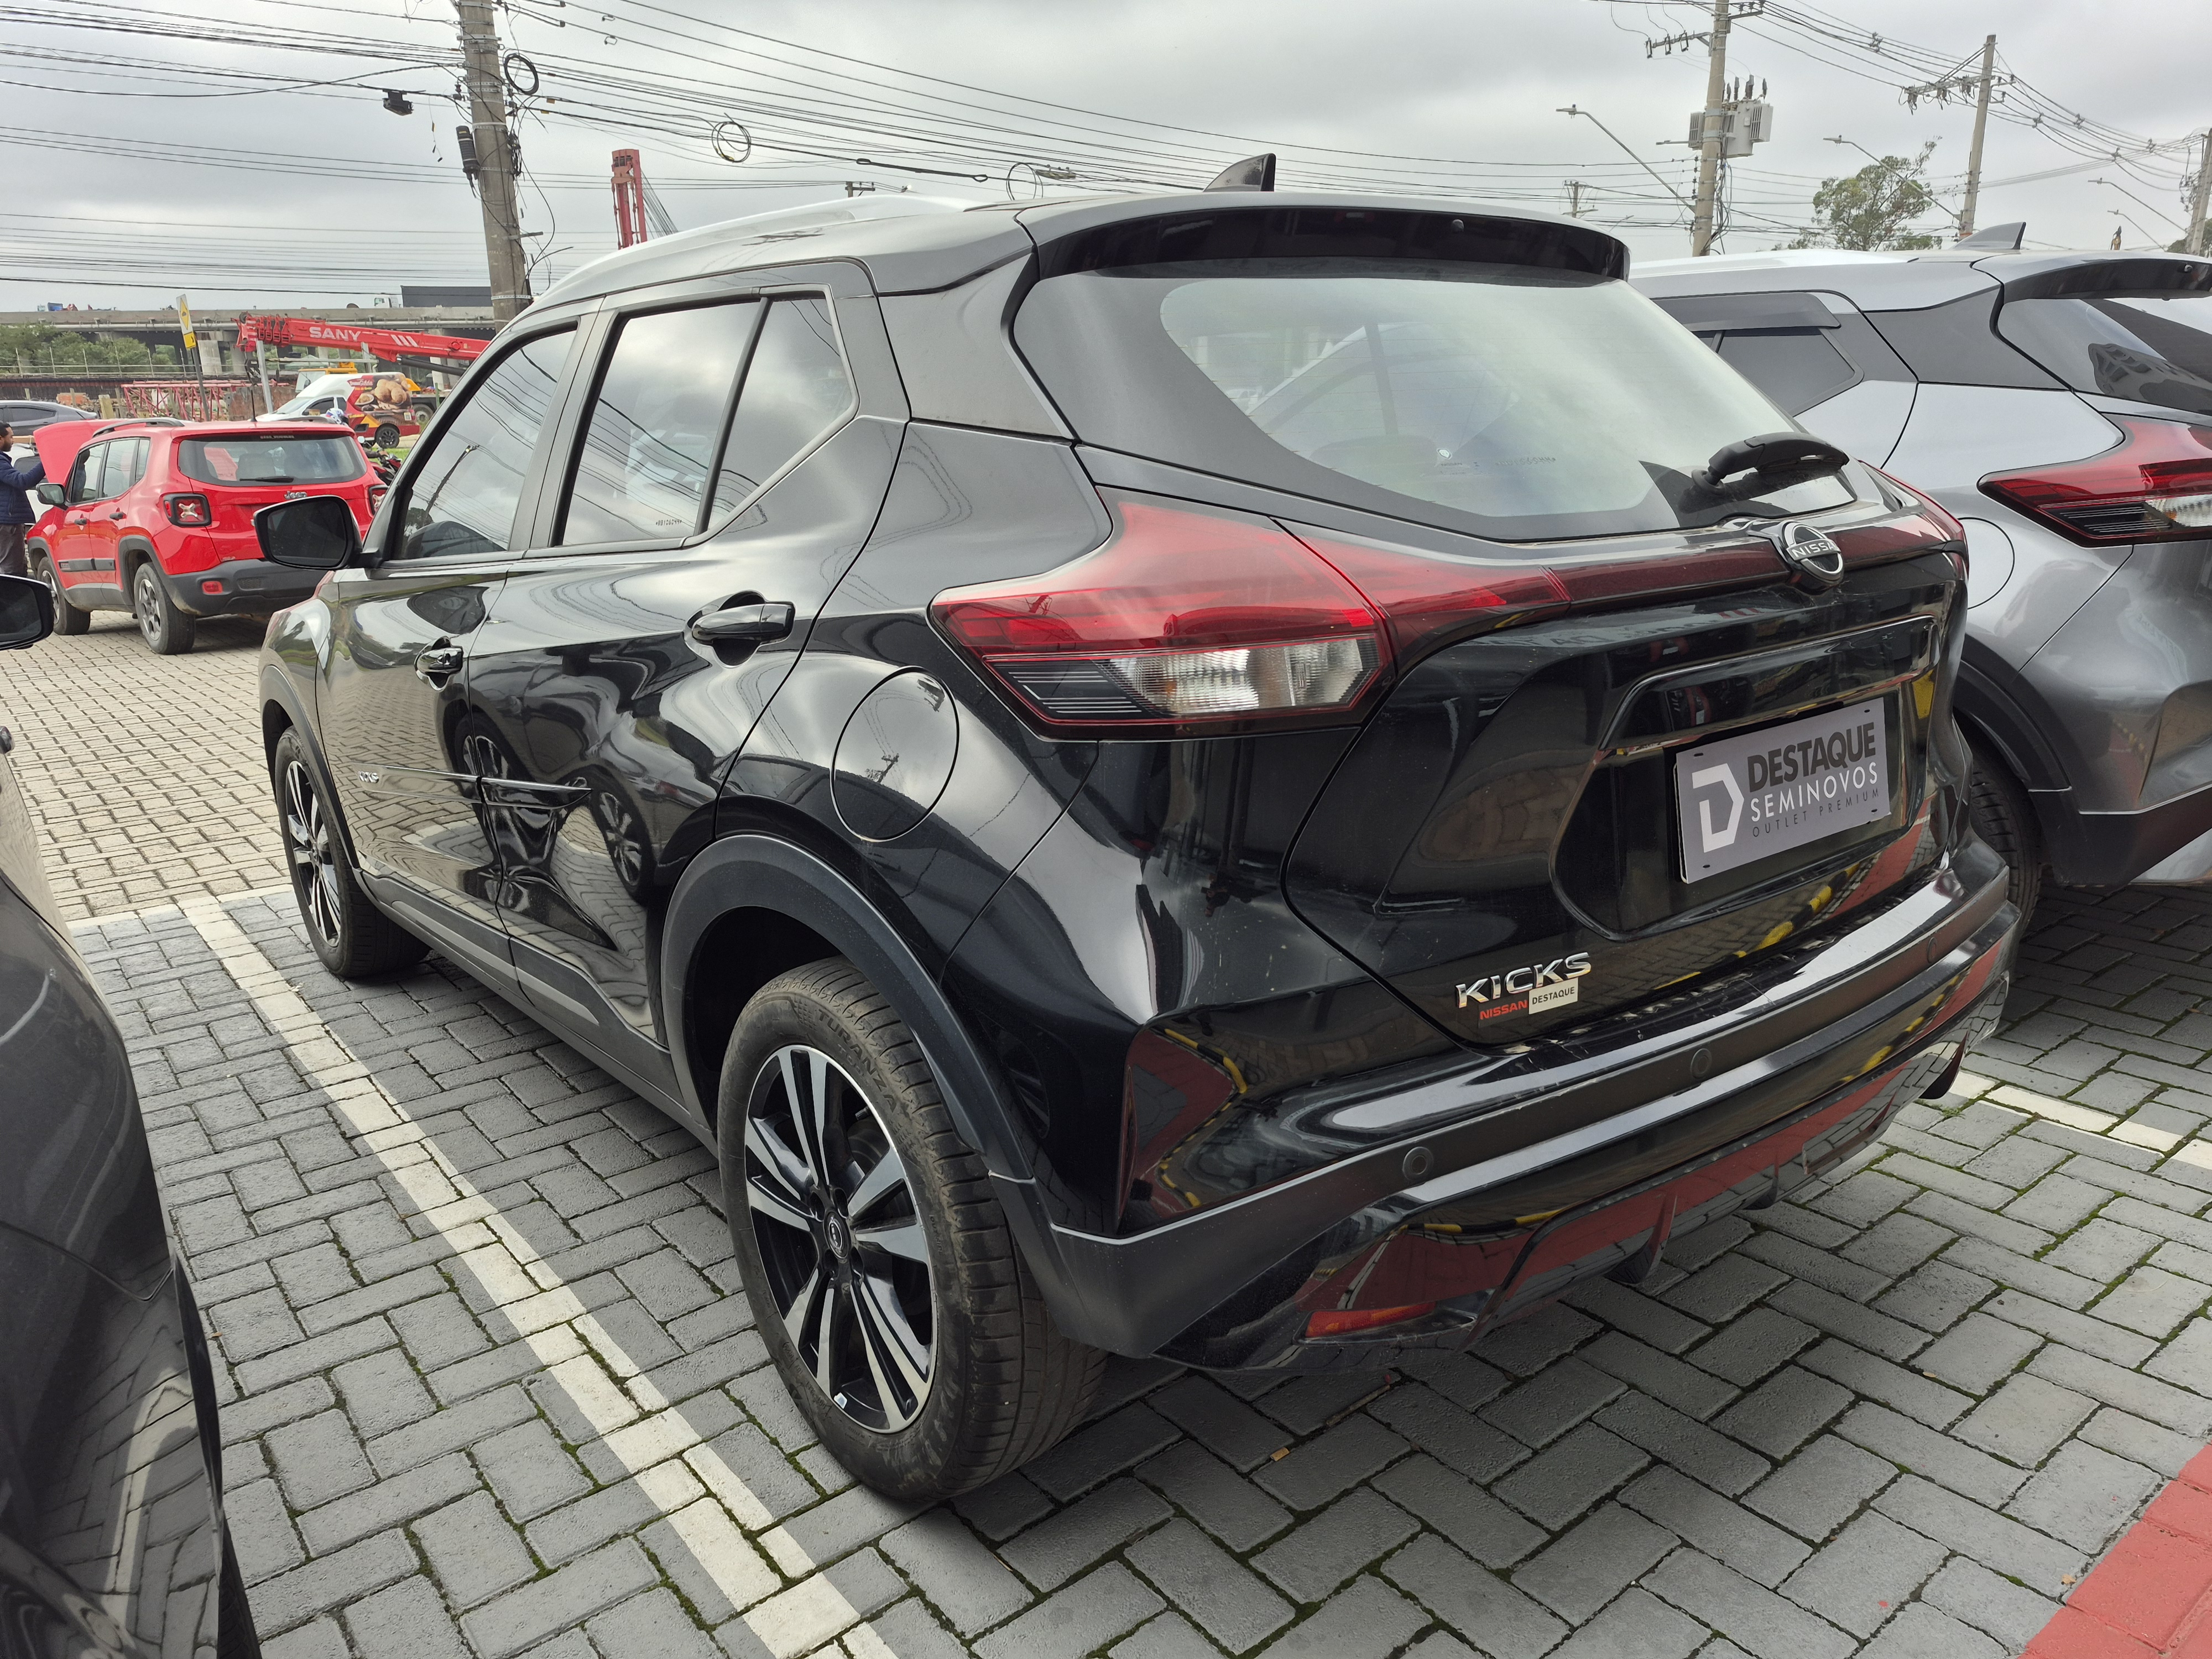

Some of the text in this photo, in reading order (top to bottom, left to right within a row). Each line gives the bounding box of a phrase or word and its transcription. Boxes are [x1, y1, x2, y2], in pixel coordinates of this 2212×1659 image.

[309, 326, 361, 342] SANY
[284, 491, 307, 499] Jeep
[1792, 542, 1837, 557] NISSA
[1747, 722, 1876, 792] DESTAQUE
[1750, 761, 1879, 822] SEMINOVOS
[1752, 788, 1880, 837] OUTLET PREMIUM
[1455, 952, 1592, 1009] KICKS
[1479, 986, 1575, 1020] NISSAN DESTAQUE
[818, 1008, 898, 1113] TURANZA
